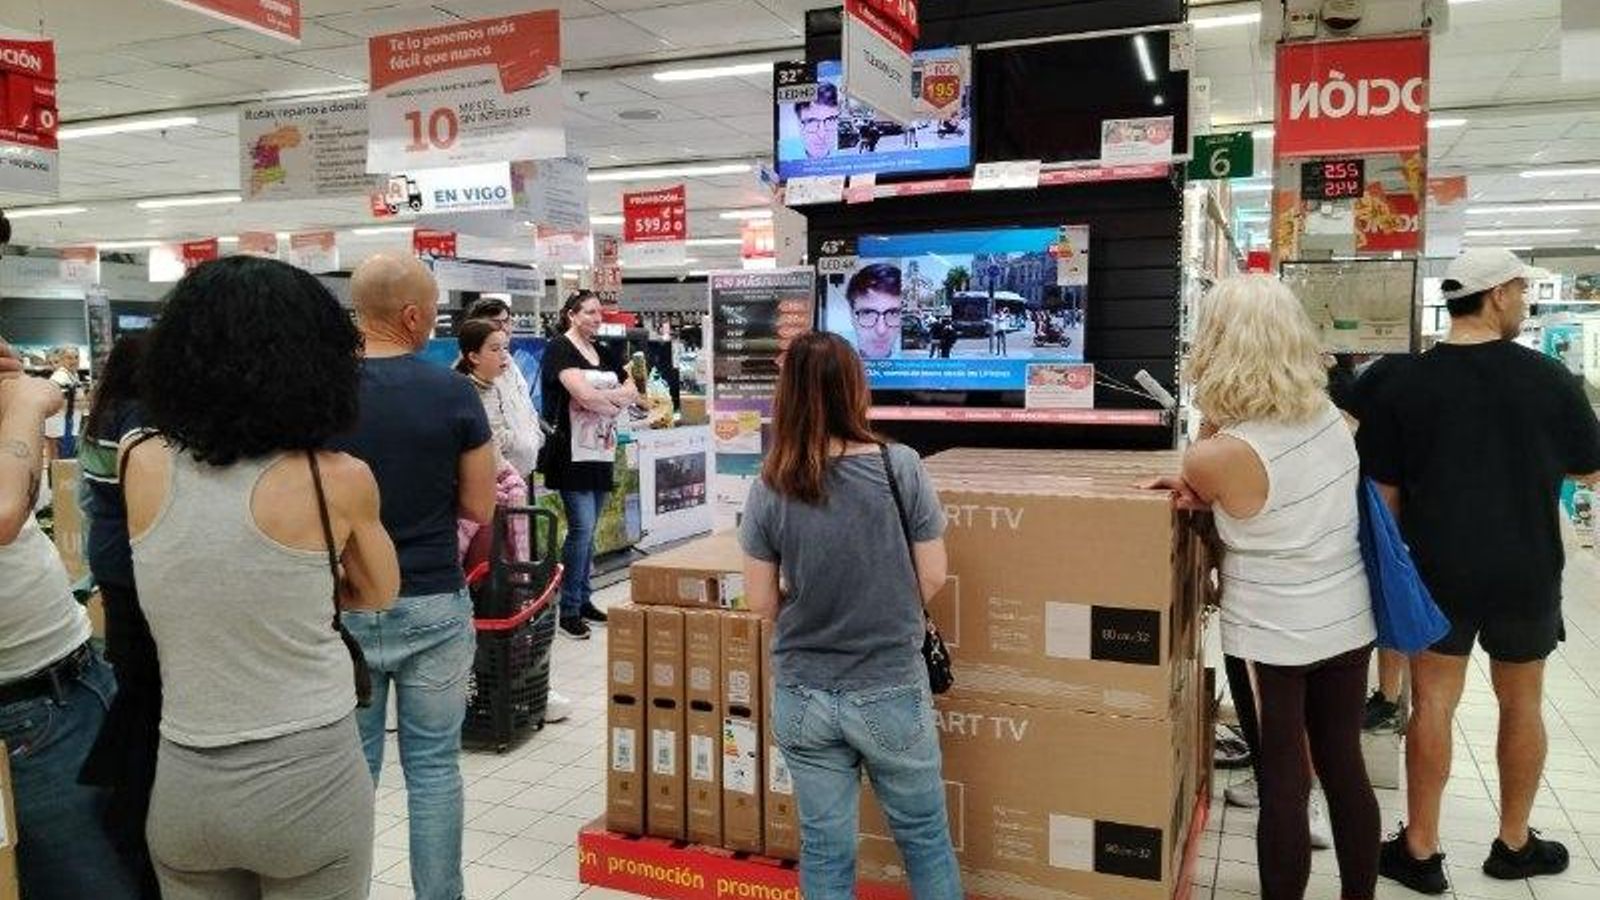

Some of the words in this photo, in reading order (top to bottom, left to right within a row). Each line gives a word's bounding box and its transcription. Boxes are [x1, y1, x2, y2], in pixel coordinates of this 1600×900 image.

[389, 38, 404, 51] Te
[407, 36, 421, 50] lo
[423, 29, 484, 50] ponemos
[487, 20, 516, 37] más
[0, 48, 42, 72] CIÓN
[389, 51, 421, 71] fácil
[422, 51, 449, 68] que
[450, 44, 493, 60] nunca
[404, 107, 459, 153] 10
[458, 99, 496, 113] MESES
[1209, 147, 1231, 178] 6
[434, 187, 457, 202] EN
[463, 185, 508, 200] VIGO
[983, 505, 1025, 530] TV
[989, 716, 1029, 741] TV
[607, 855, 705, 889] promoción
